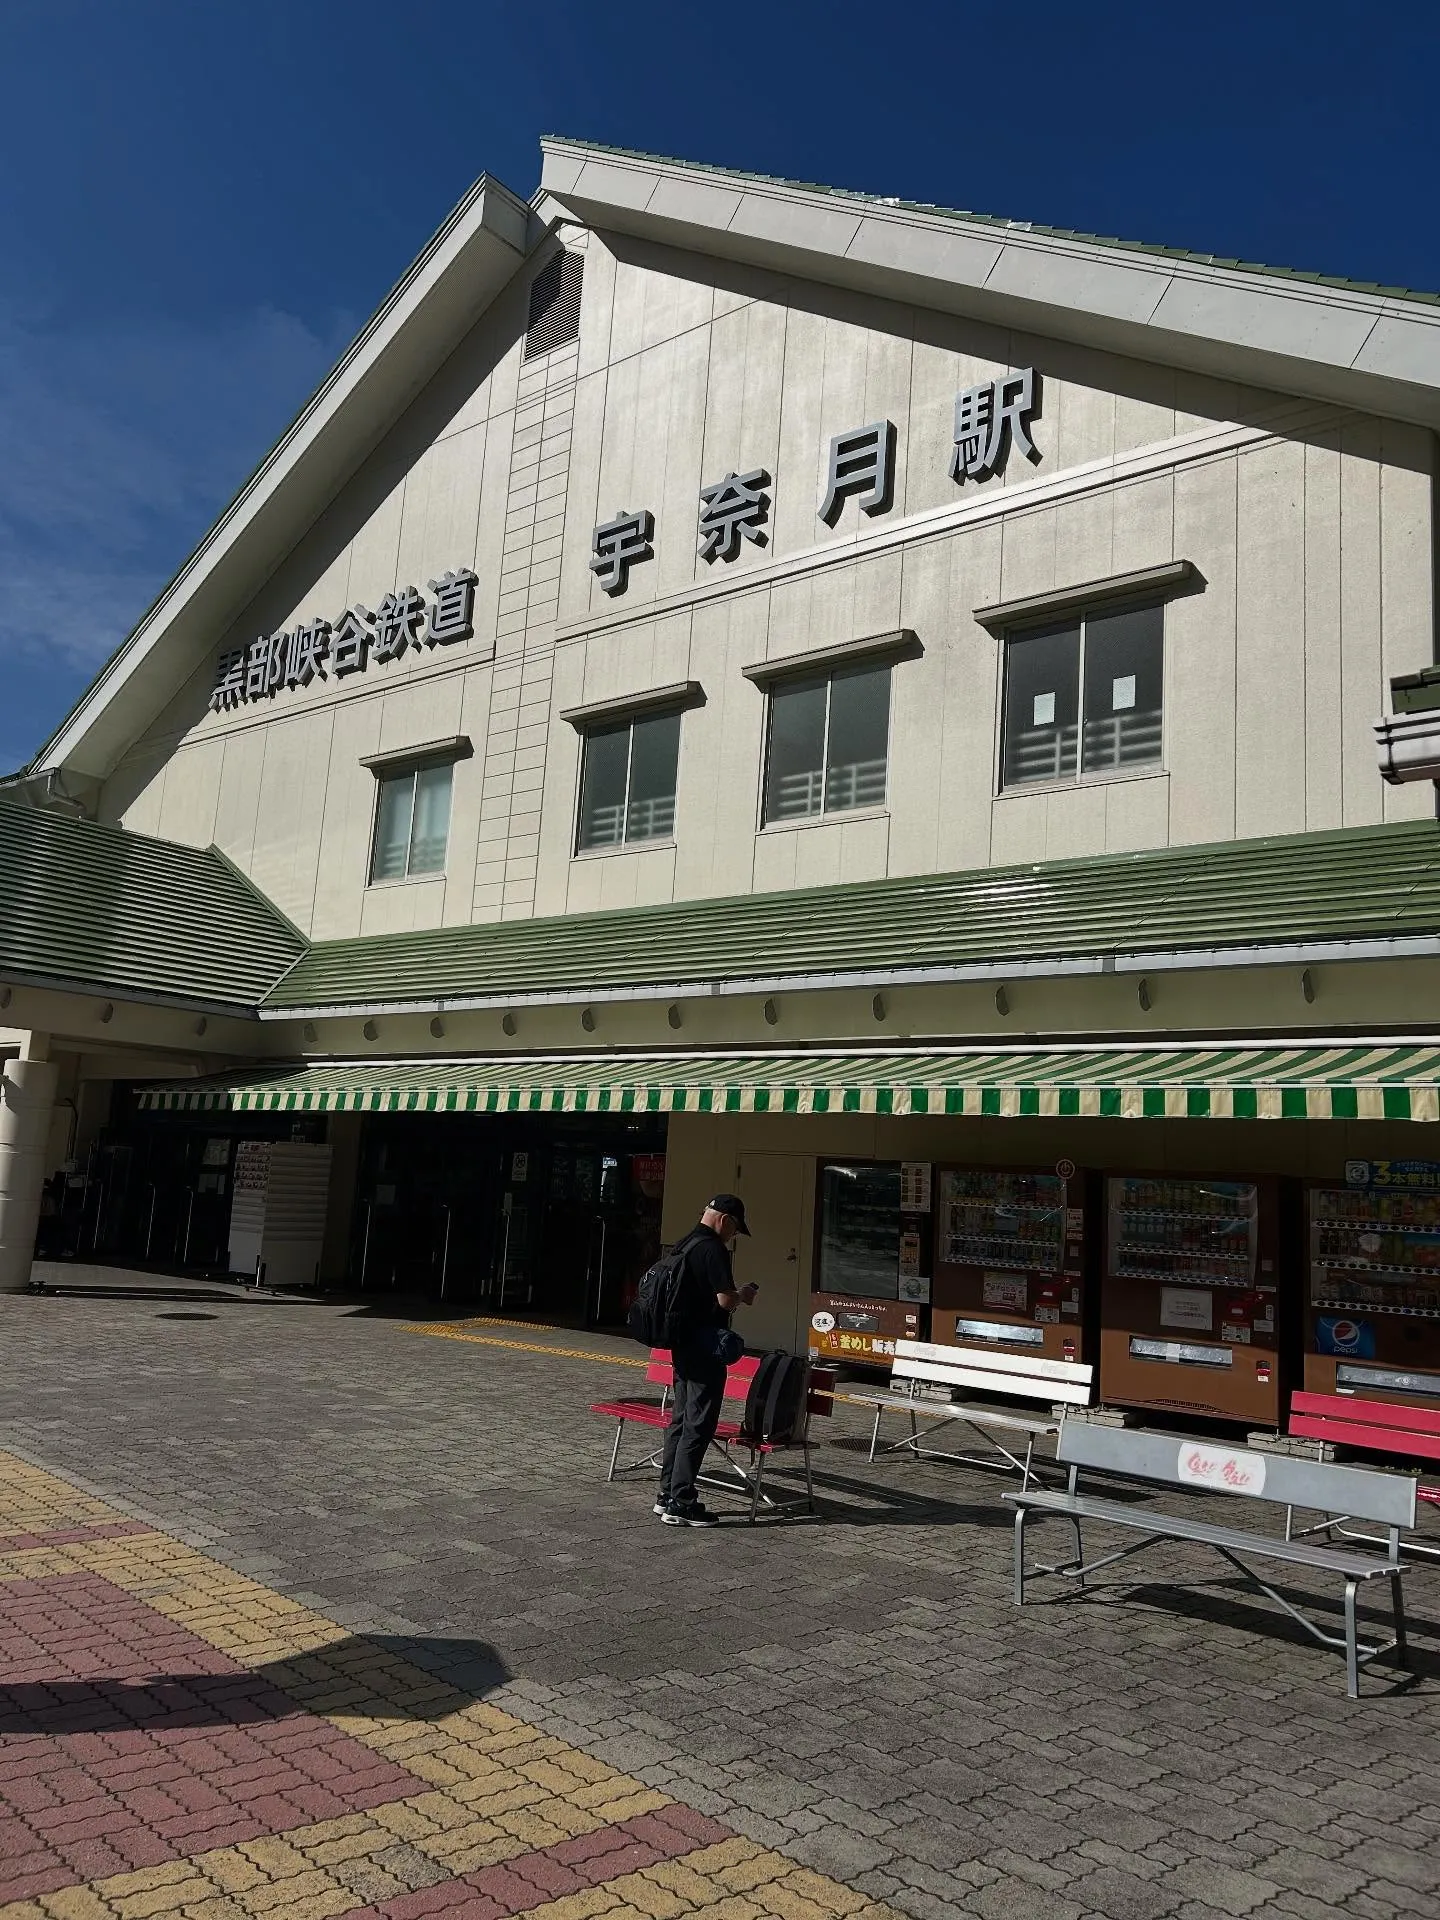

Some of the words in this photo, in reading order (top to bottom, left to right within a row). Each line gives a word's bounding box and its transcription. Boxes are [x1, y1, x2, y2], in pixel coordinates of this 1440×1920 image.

[589, 366, 1043, 598] 宇奈月駅
[208, 567, 479, 713] 黒部峡谷鉄道
